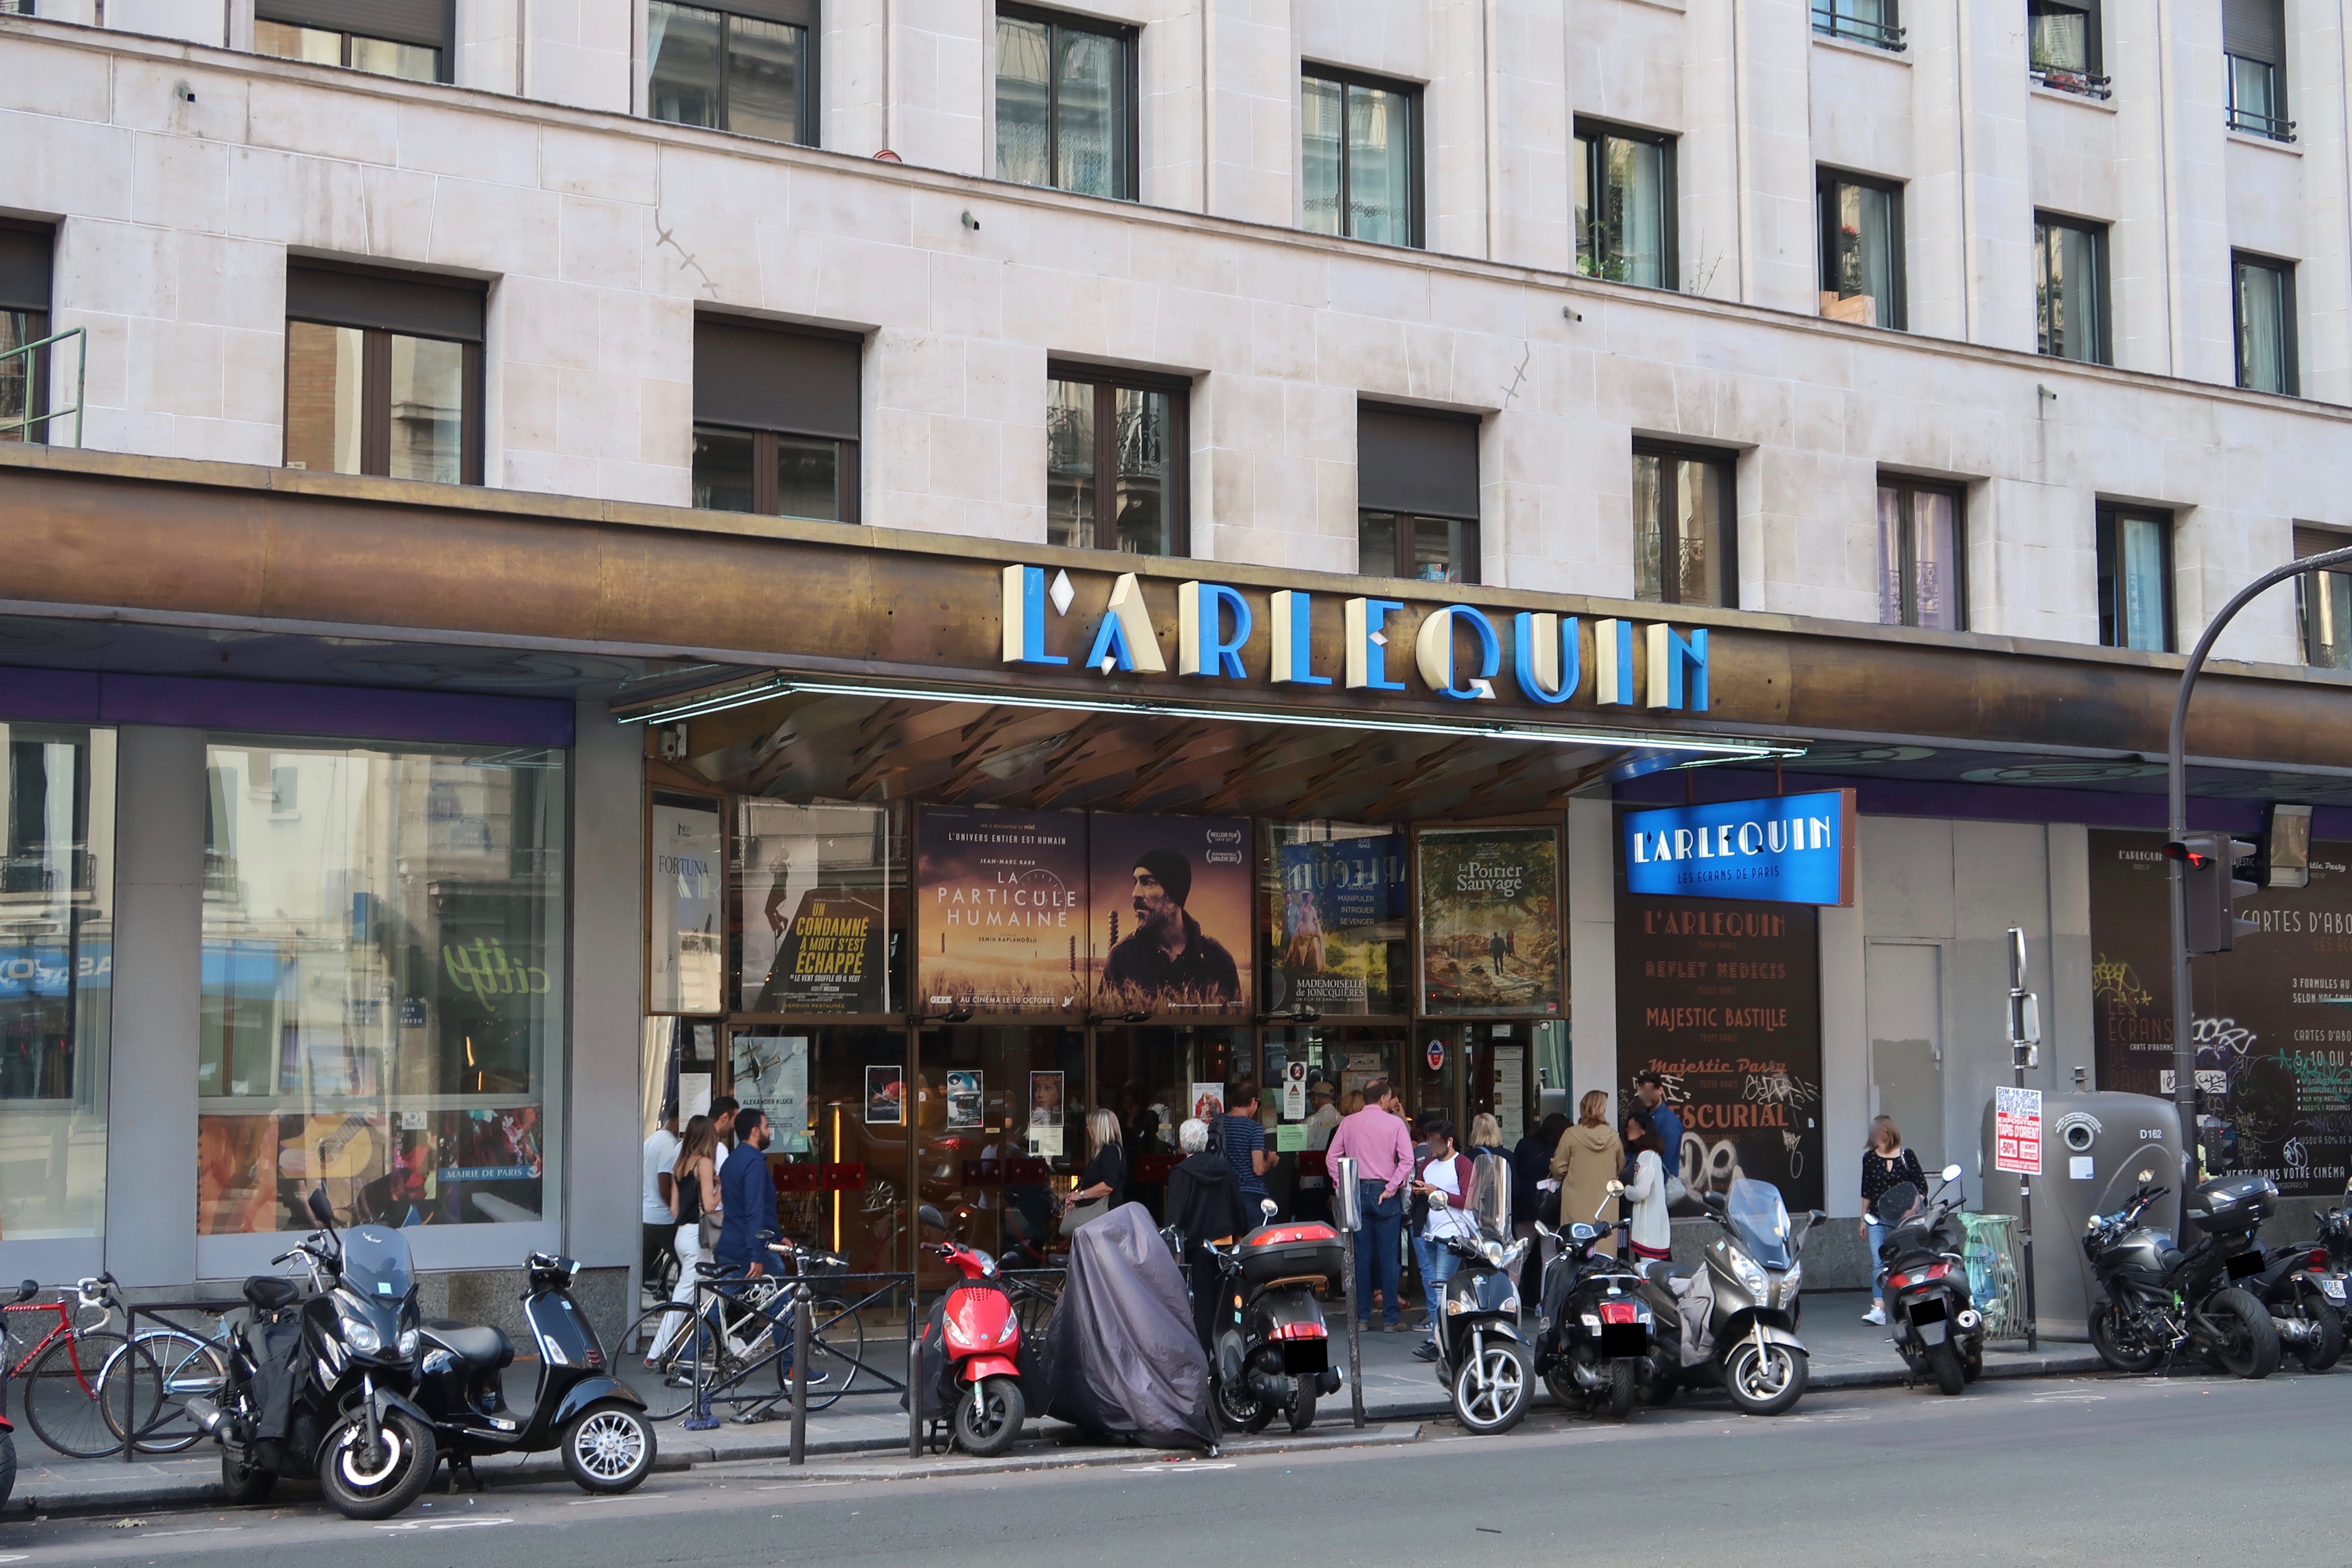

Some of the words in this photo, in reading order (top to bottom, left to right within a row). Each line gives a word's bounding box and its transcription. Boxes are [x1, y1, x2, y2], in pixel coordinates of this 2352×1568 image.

[1002, 564, 1708, 711] L'ARLEQUIN
[948, 832, 988, 842] L'UNIVERS
[992, 834, 1018, 844] ENTIER
[1022, 836, 1035, 844] EST
[1038, 837, 1066, 845] HUMAIN
[1634, 815, 1830, 863] L'ARLEQUIN
[658, 854, 709, 878] FORTUNA
[1458, 863, 1469, 872] Le
[1467, 862, 1523, 879] Poirier
[2233, 858, 2255, 868] AJESTIC
[998, 871, 1018, 884] LA
[1678, 873, 1693, 884] LES
[1698, 869, 1732, 882] ÉCRANS
[1736, 868, 1747, 879] DE
[1752, 865, 1780, 878] PARIS
[1457, 874, 1522, 897] Sauvage
[938, 887, 1075, 907] PARTICULE
[812, 903, 826, 916] UN
[947, 909, 1067, 928] HUMAINE
[1645, 910, 1785, 937] L'ARLEQUIN
[796, 917, 870, 937] CONDAMNÉ
[808, 937, 836, 951] MORT
[838, 937, 866, 952] S'EST
[795, 950, 864, 974] ÉCHAPPÉ
[1645, 961, 1708, 978] REFLET
[1717, 962, 1786, 979] MEDICIS
[1297, 979, 1364, 988] MADEMOISELLE
[2292, 978, 2297, 988] 3
[2300, 978, 2337, 989] FORMULES
[2340, 979, 2350, 989] AU
[972, 995, 1001, 1004] CINÉMA
[1296, 988, 1305, 996] de
[2293, 993, 2316, 1003] SELON
[1646, 1008, 1718, 1032] MAJESTIC
[1725, 1008, 1787, 1032] BASTILLE
[2294, 1029, 2325, 1041] CARTES
[2310, 1050, 2323, 1066] 10
[2329, 1050, 2344, 1066] OU
[1648, 1059, 1734, 1078] Majestic
[2022, 1090, 2039, 1099] SEPT
[1999, 1117, 2040, 1127] EXPOSITION
[1999, 1123, 2014, 1137] TAPIS
[2014, 1124, 2039, 1139] D'ORIENT
[2140, 1129, 2162, 1139] D162
[2001, 1141, 2016, 1155] -50%
[447, 1170, 478, 1178] MAIRIE
[482, 1169, 494, 1177] DE
[497, 1168, 522, 1177] PARIS
[2257, 1168, 2280, 1180] DANS
[2283, 1167, 2310, 1179] VOTRE
[2313, 1164, 2345, 1178] CINÉMA
